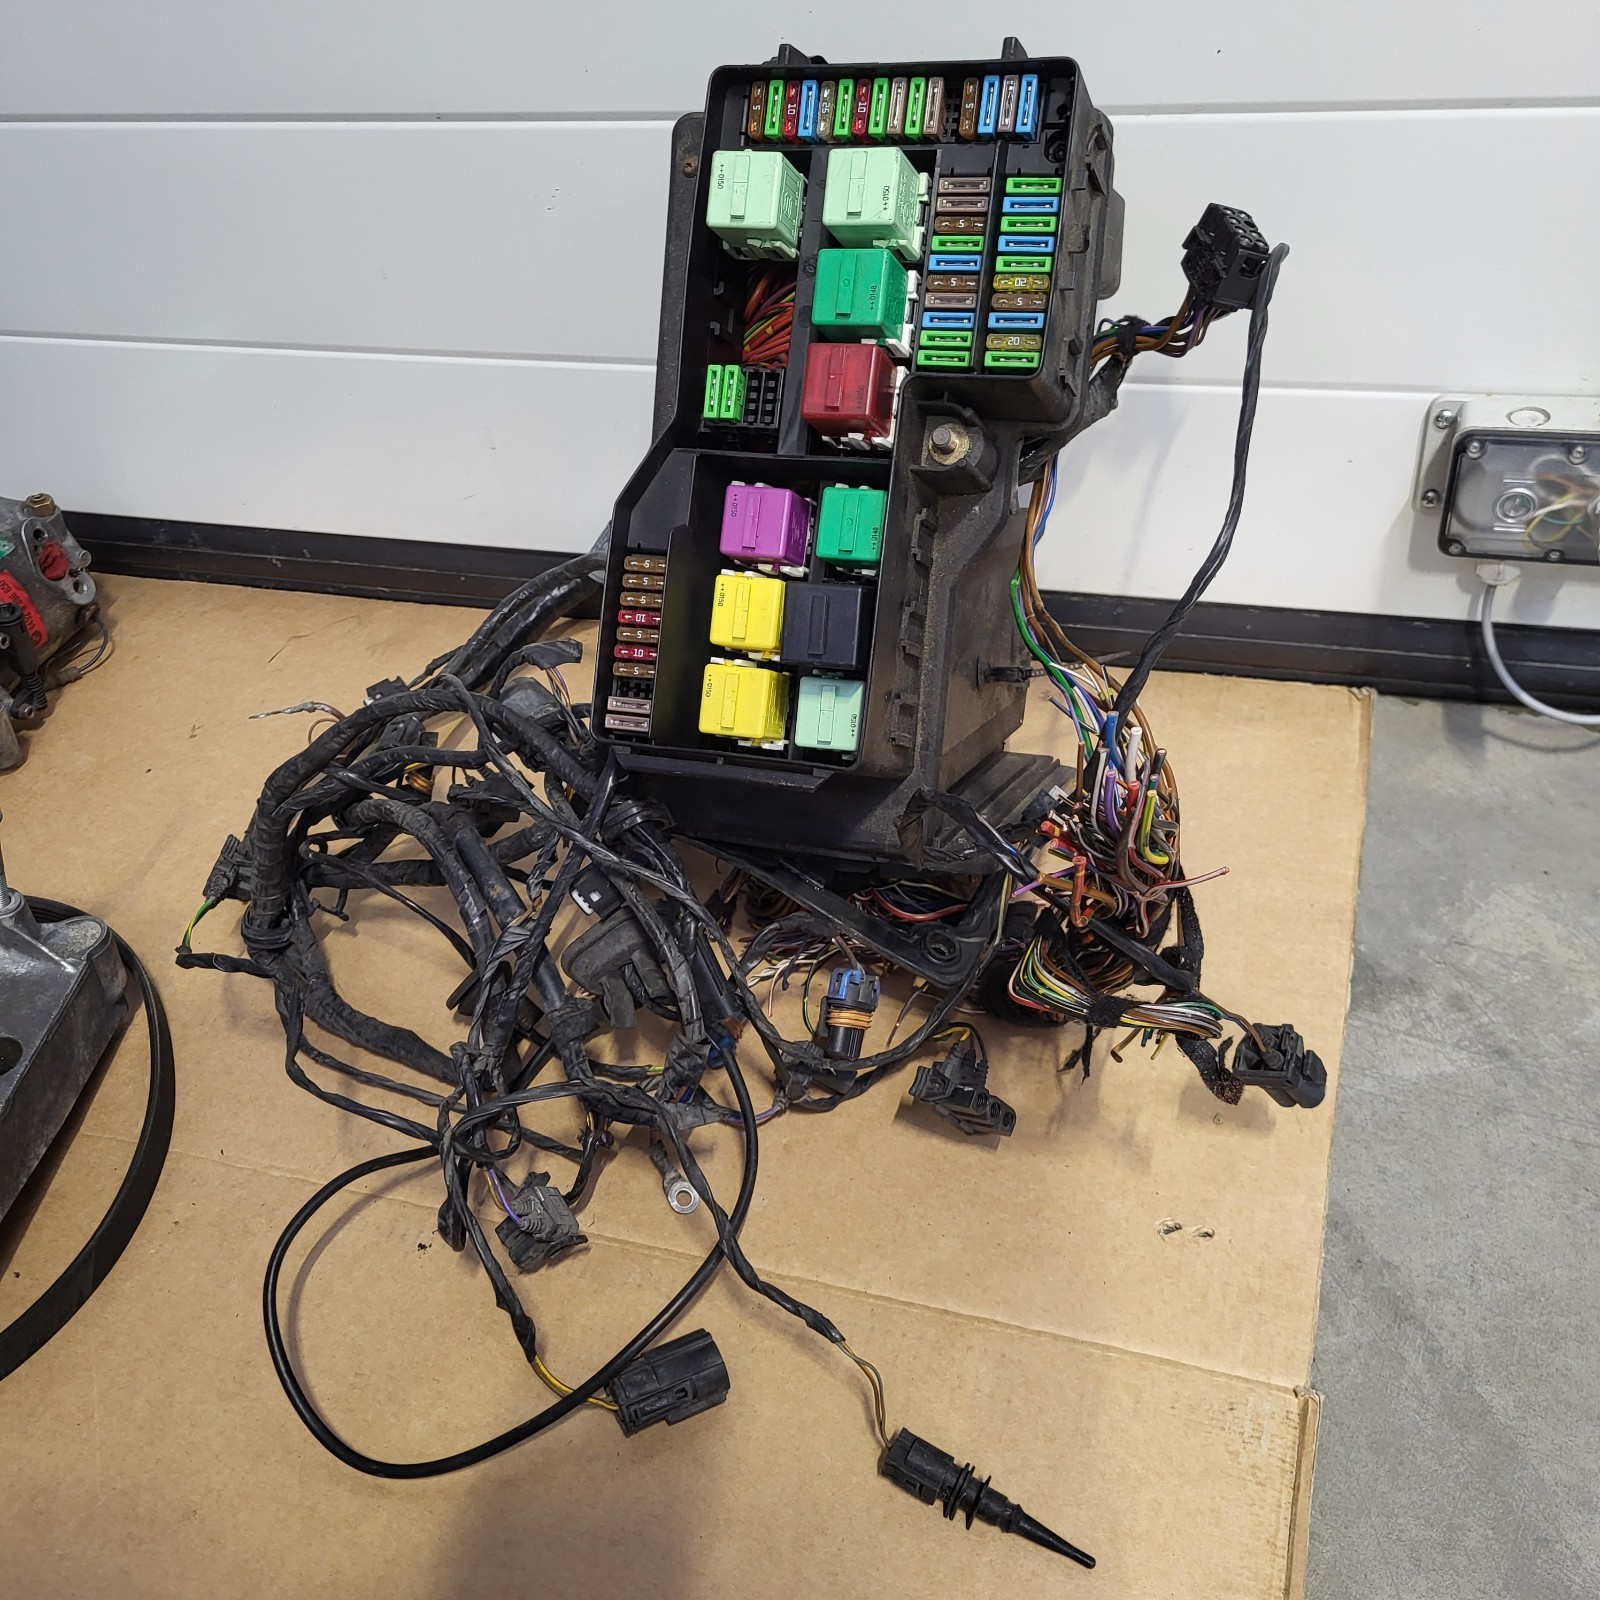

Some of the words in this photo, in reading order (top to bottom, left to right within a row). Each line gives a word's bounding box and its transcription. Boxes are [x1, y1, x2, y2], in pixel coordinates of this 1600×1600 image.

[787, 103, 797, 115] 10
[822, 102, 831, 114] 25
[857, 101, 867, 113] 10
[958, 219, 965, 228] 5
[950, 277, 957, 287] 5
[1014, 277, 1027, 287] 20
[1016, 297, 1023, 306] 5
[1007, 336, 1020, 346] 20
[644, 559, 650, 568] 5
[642, 577, 649, 586] 5
[640, 595, 647, 604] 5
[635, 613, 647, 623] 10
[636, 630, 643, 639] 5
[633, 648, 644, 658] 10
[633, 666, 640, 675] 5
